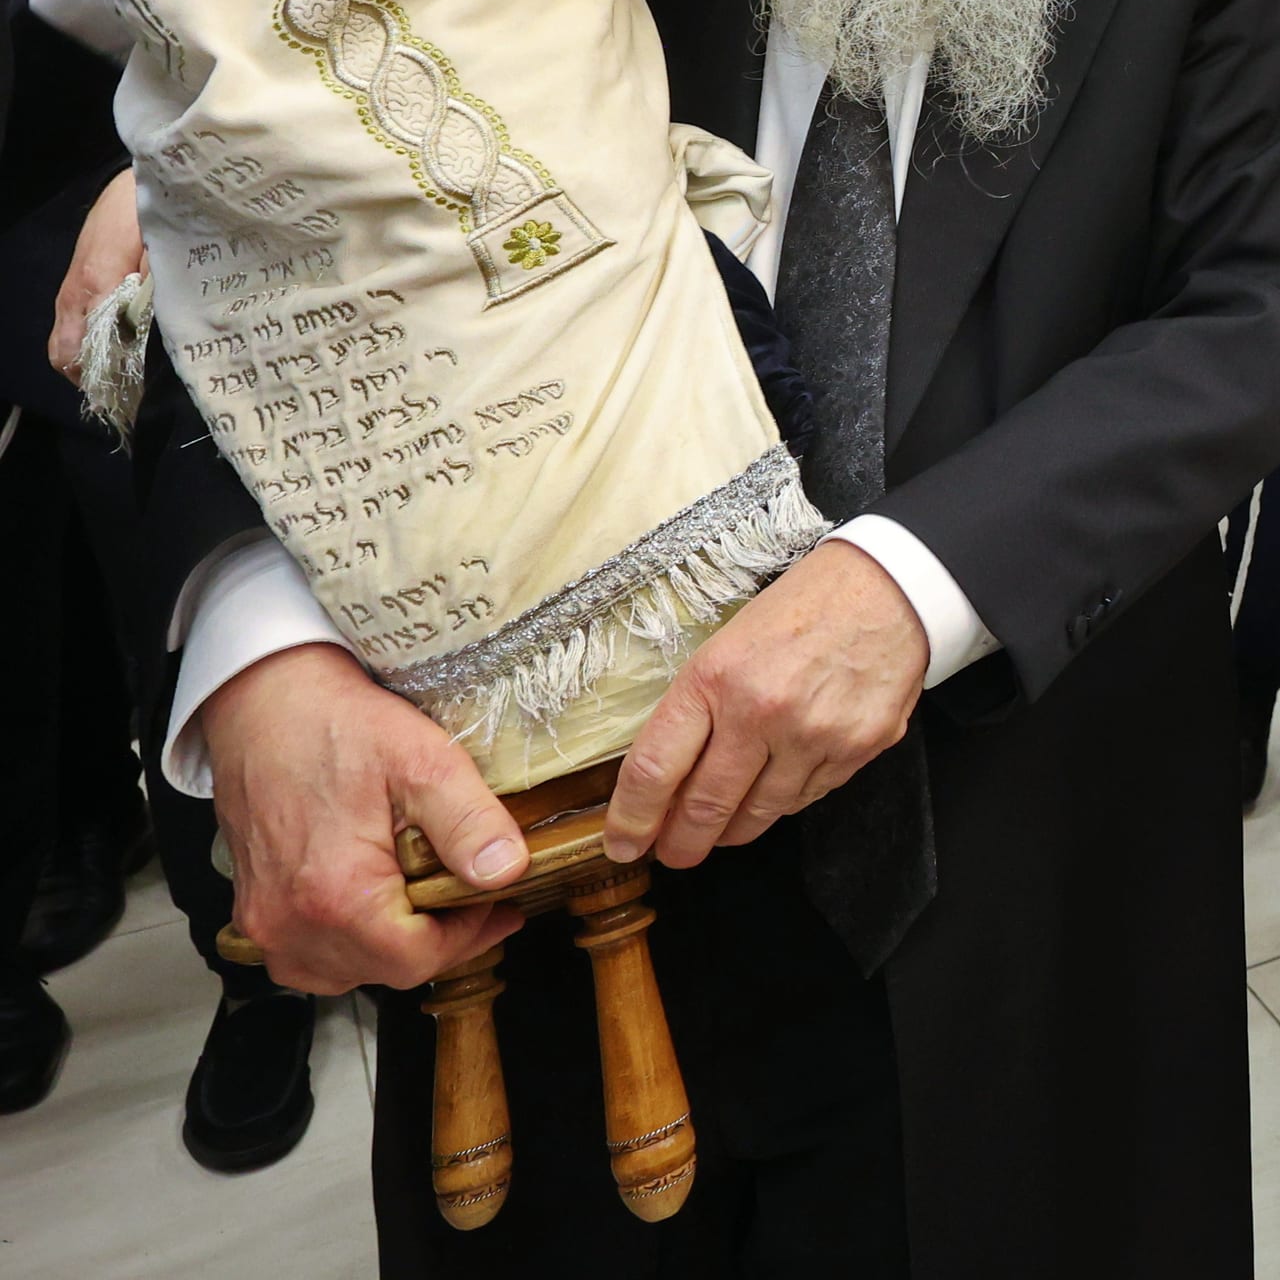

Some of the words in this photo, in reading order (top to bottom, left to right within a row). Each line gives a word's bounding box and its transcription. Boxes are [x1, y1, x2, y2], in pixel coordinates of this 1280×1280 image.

[252, 312, 284, 341] לוי
[291, 299, 358, 336] מנחם
[350, 363, 408, 402] יוסף
[253, 395, 299, 433] ציון
[309, 385, 341, 418] בן
[424, 456, 475, 486] לוי
[379, 572, 447, 618] יוסף
[340, 601, 375, 631] בן
